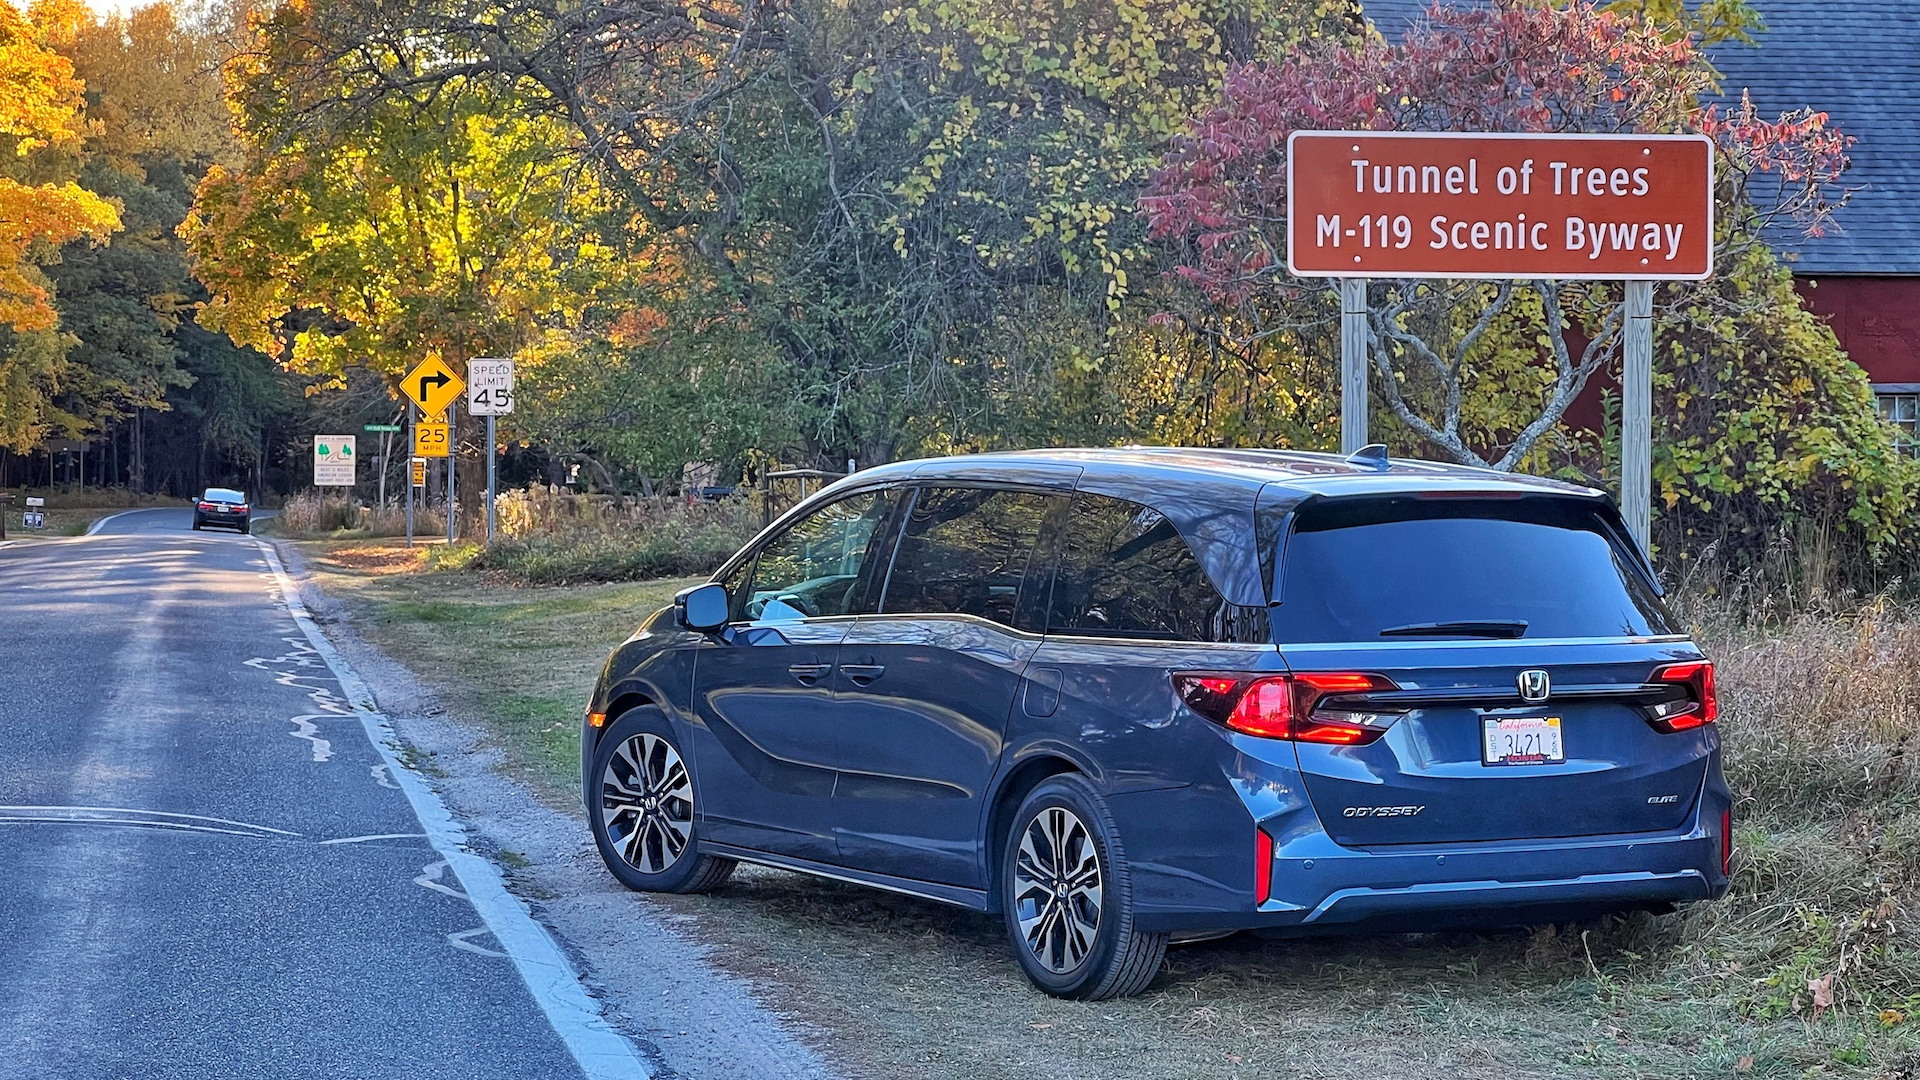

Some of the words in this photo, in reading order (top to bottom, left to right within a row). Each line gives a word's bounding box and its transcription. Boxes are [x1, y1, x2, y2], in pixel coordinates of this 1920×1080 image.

[1351, 158, 1479, 195] Tunnel
[1496, 159, 1534, 195] of
[1549, 161, 1650, 197] Trees
[1316, 214, 1412, 248] M-119
[1429, 213, 1549, 251] Scenic
[1565, 216, 1684, 260] Byway
[473, 366, 510, 375] SPEED
[477, 377, 505, 386] LIMIT
[473, 388, 510, 407] 45
[419, 428, 445, 443] 25
[1499, 719, 1547, 732] California
[1504, 733, 1542, 756] 3421
[1647, 794, 1679, 804] ELITE
[1343, 805, 1426, 817] ODYSSEY
